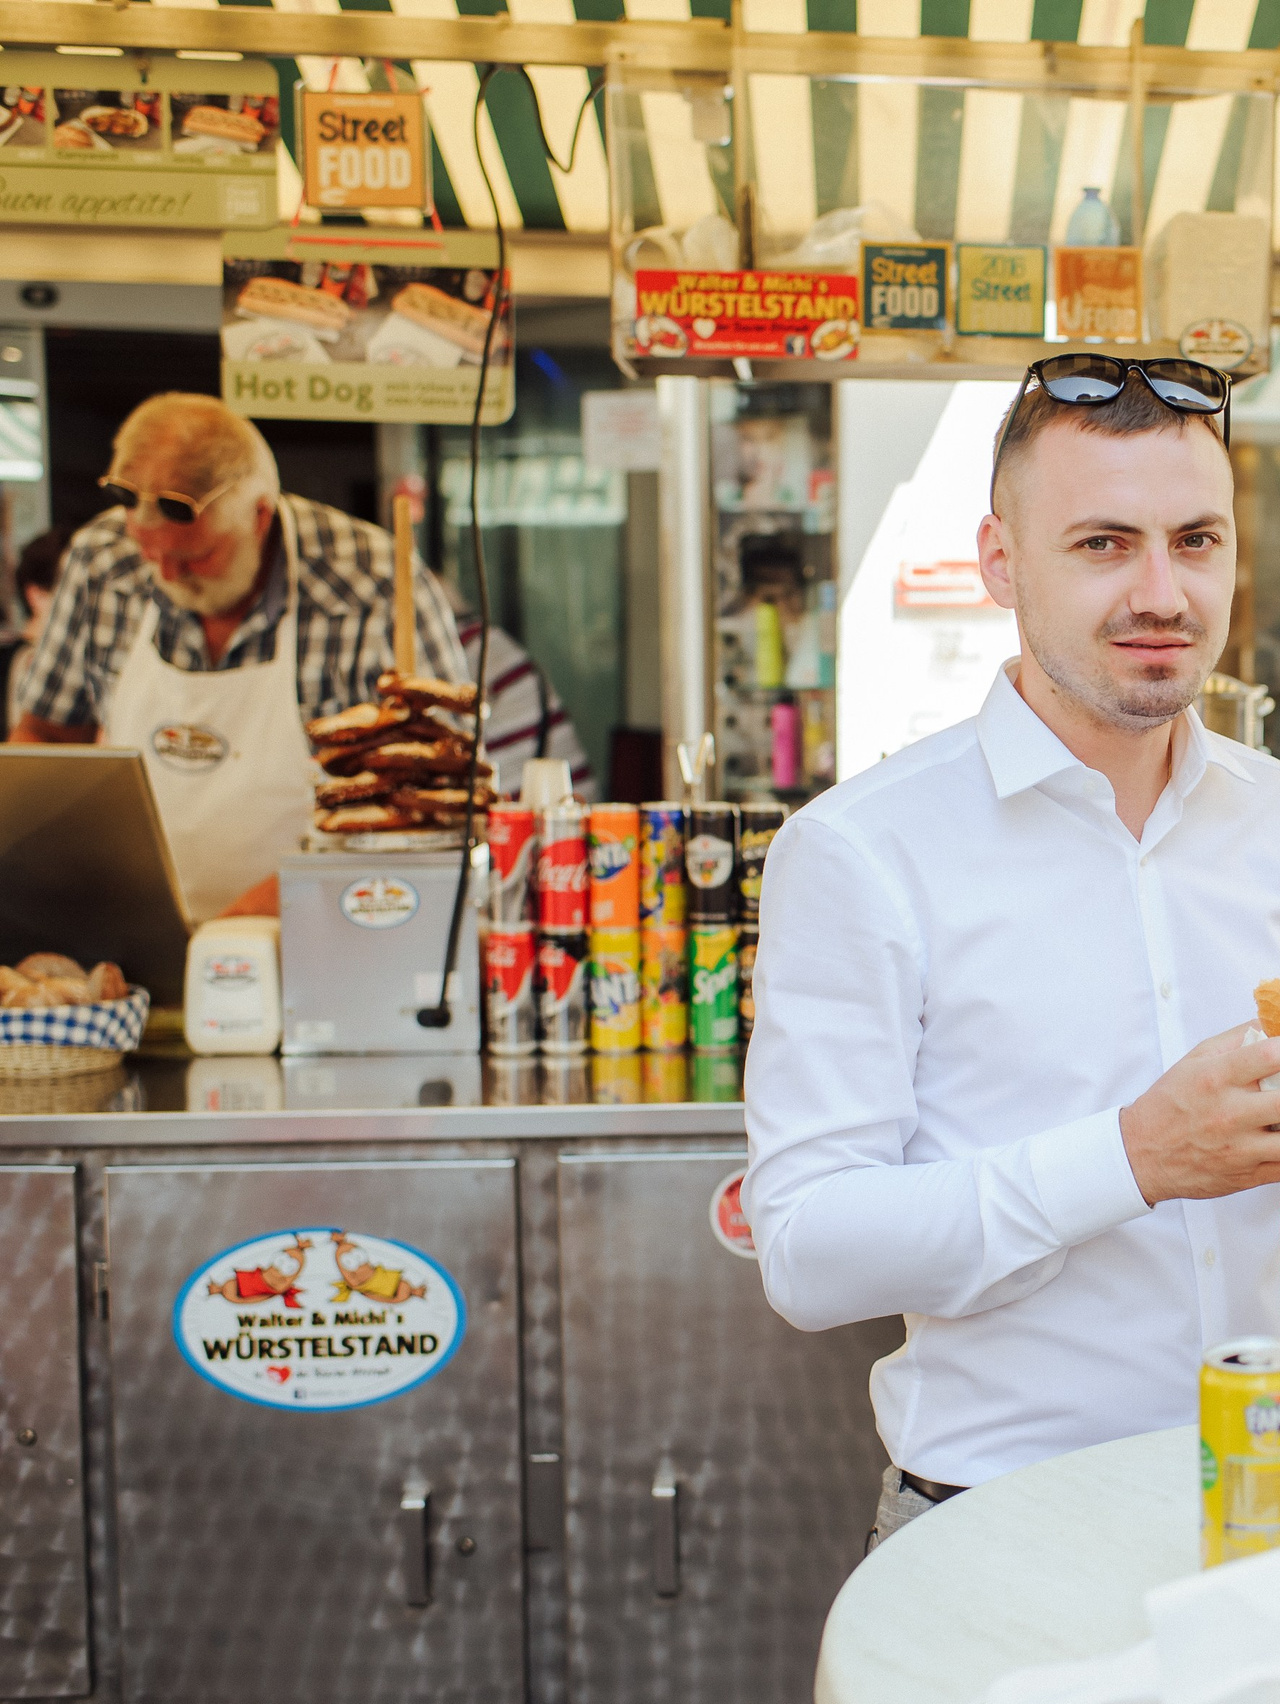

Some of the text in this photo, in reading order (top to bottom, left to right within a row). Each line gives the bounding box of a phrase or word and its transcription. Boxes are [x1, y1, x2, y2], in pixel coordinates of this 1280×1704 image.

[319, 111, 407, 143] Street
[318, 146, 411, 190] FOOD
[677, 275, 739, 292] Walter
[742, 273, 759, 292] &
[871, 256, 938, 284] Street
[640, 286, 856, 320] WÜRSTELSTAND
[871, 284, 939, 318] FOOD
[970, 277, 1032, 302] Street
[234, 371, 374, 412] Hot Dog
[237, 1312, 303, 1328] Walter
[311, 1312, 325, 1326] &
[203, 1331, 439, 1360] WÜRSTELSTAND
